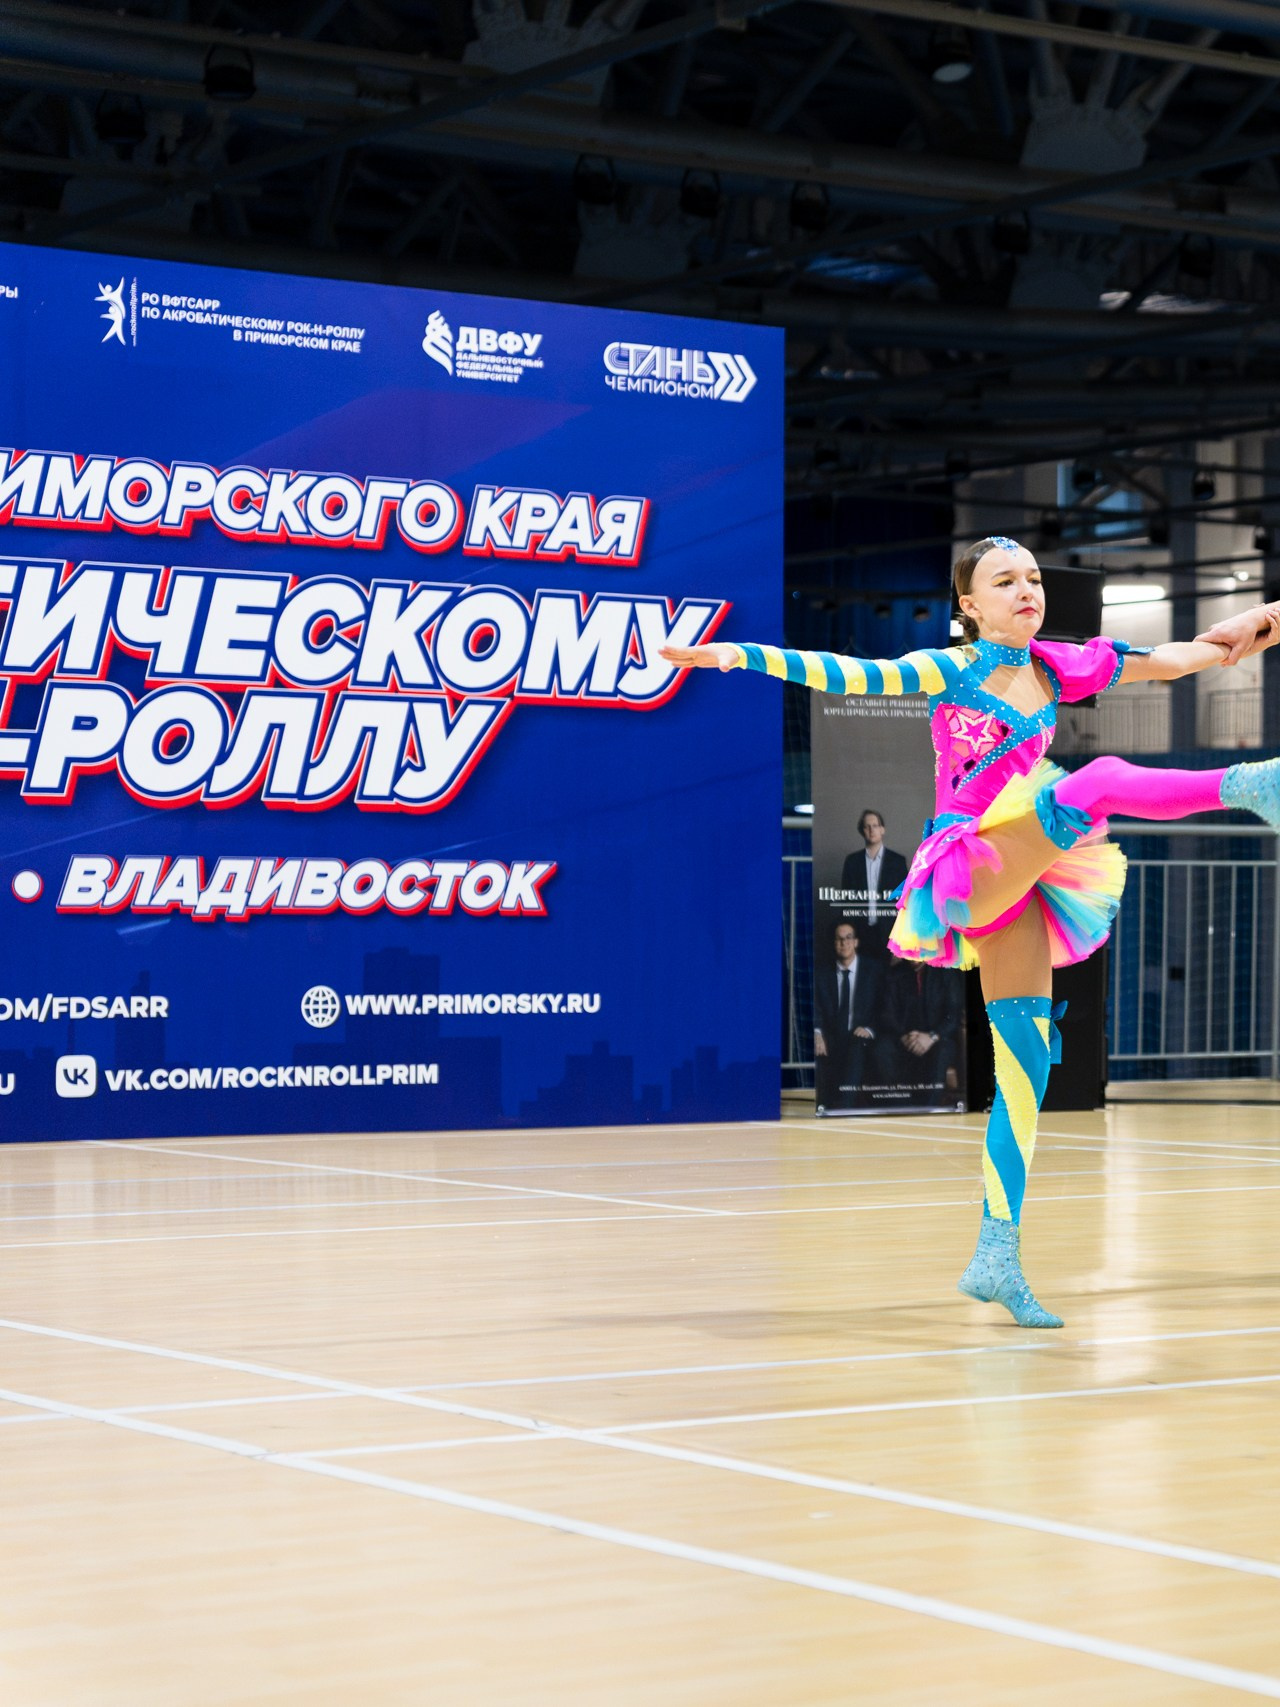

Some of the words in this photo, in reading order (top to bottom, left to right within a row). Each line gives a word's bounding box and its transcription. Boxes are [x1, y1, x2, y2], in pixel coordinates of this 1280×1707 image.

[141, 292, 159, 305] РО
[162, 294, 220, 311] ВФТСАРР
[141, 306, 160, 319] ПО
[162, 308, 284, 331] АКРОБАТИЧЕСКОМУ
[286, 321, 365, 339] РОК-Н-РОЛЛУ
[233, 329, 242, 341] В
[244, 330, 329, 350] ПРИМОРСКОМ
[331, 339, 361, 353] КРАЕ
[455, 326, 543, 356] ДВФУ
[603, 342, 715, 384] СТАНЬ
[604, 375, 715, 400] ЧЕМПИОНОМ
[466, 486, 645, 559] КРАЯ
[57, 855, 556, 917] ВЛАДИВОСТОК
[345, 993, 601, 1015] WWW.PRIMORSKY.RU
[104, 1064, 439, 1091] VK.COM/ROCKNROLLPRIM
